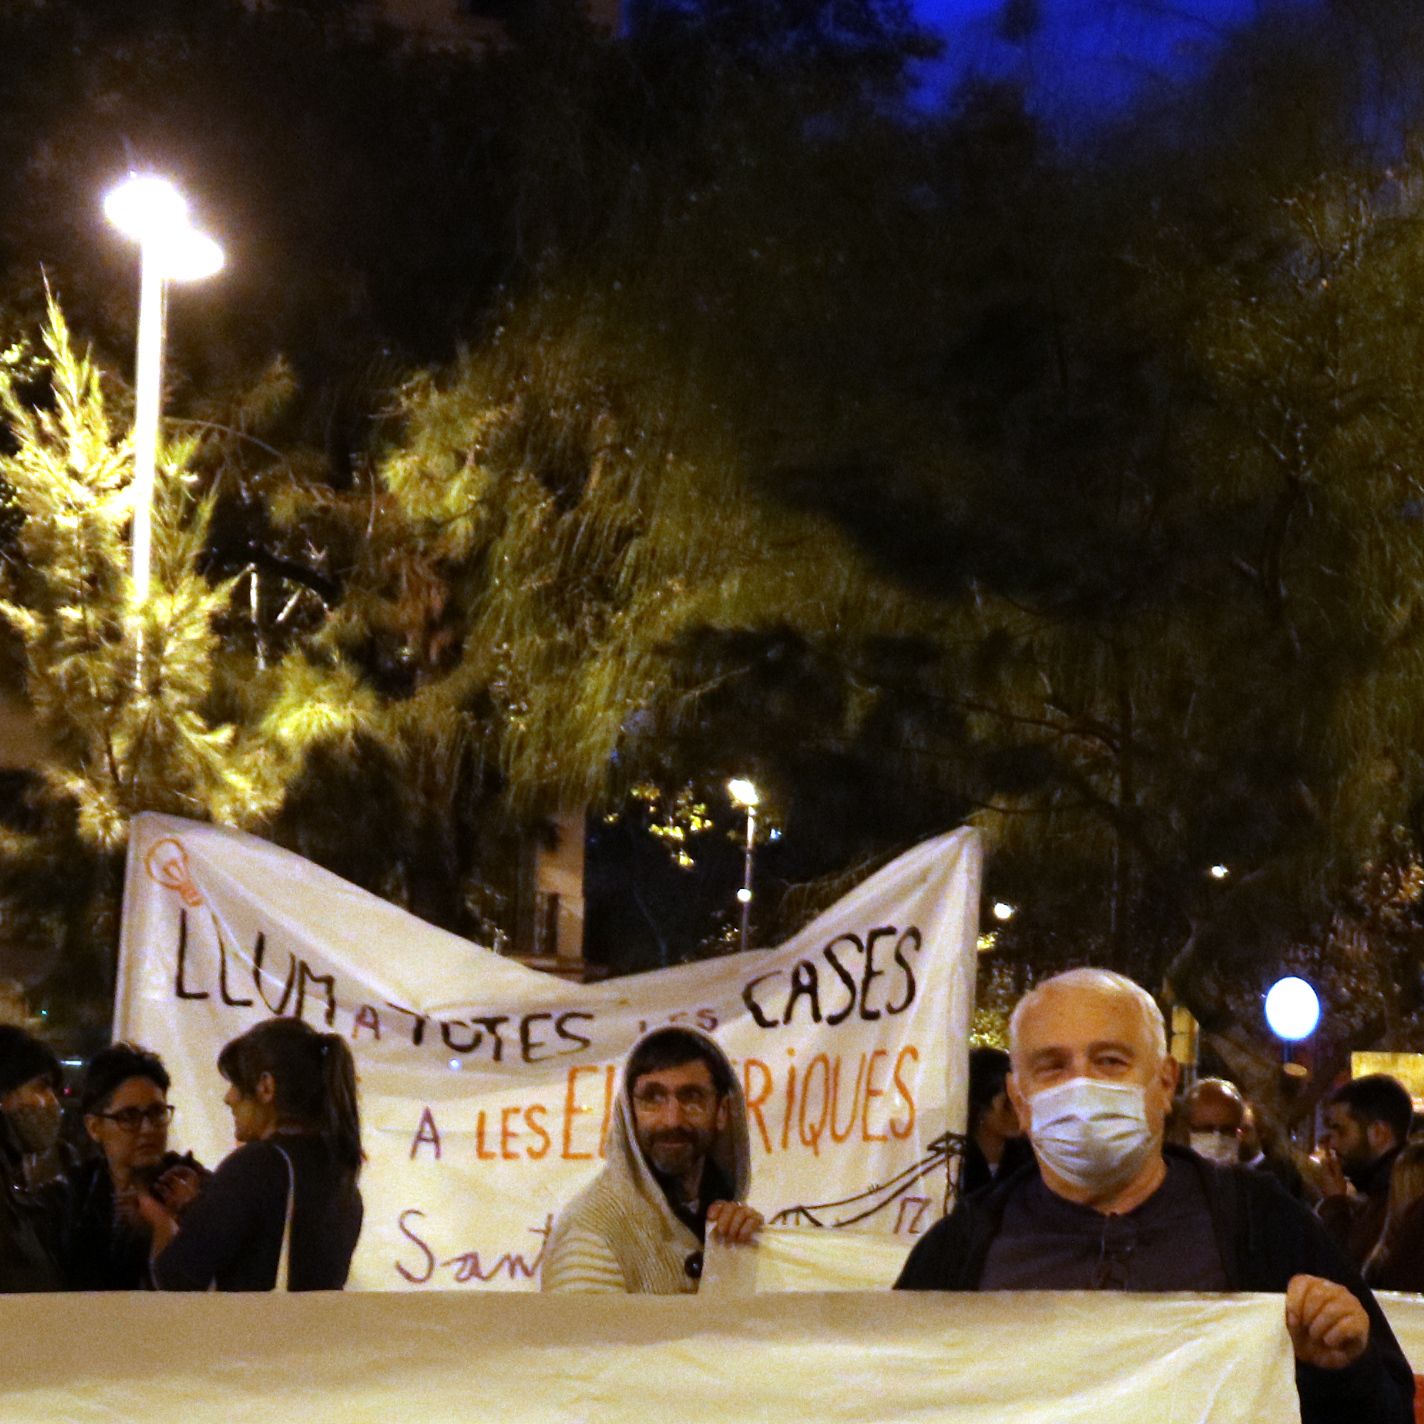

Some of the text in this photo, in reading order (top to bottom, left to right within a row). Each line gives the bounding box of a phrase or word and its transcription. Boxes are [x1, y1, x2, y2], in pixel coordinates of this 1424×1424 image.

[175, 907, 923, 1065] LLUM A TOTES CASES
[409, 1105, 442, 1161] A
[476, 1102, 553, 1162] LES
